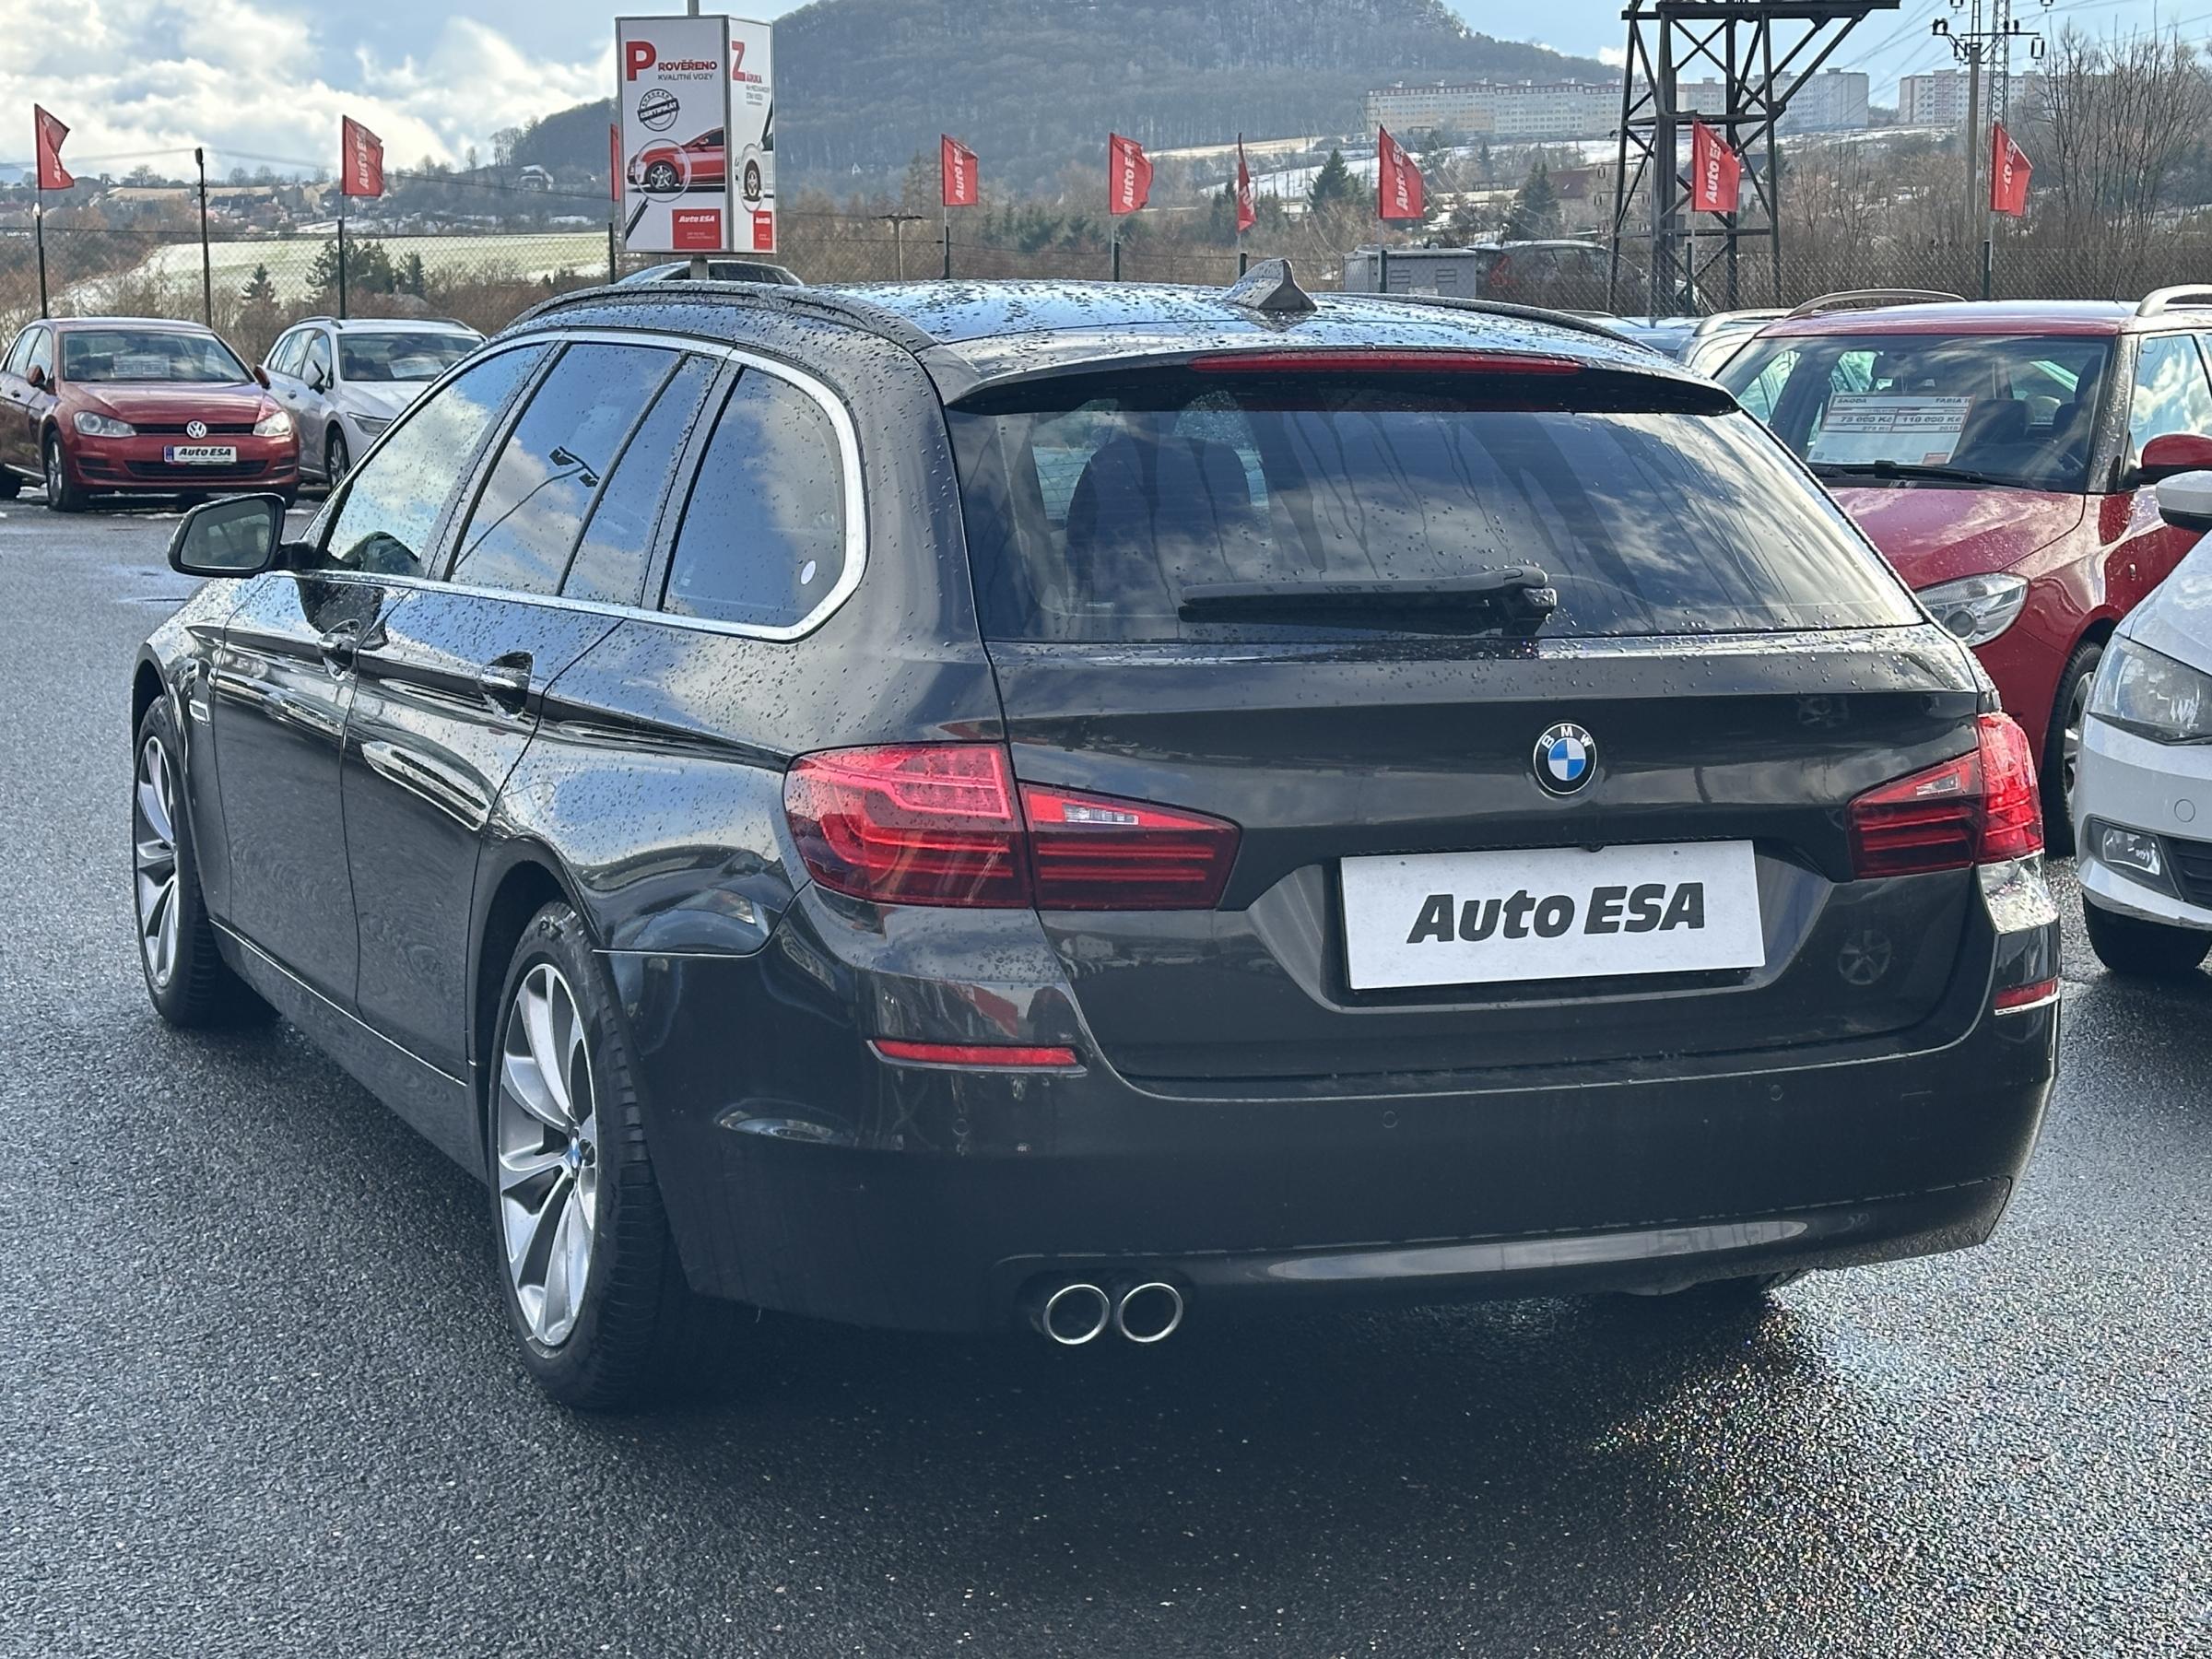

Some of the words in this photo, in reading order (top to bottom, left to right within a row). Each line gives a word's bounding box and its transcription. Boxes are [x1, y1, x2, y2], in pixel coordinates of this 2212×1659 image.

[657, 71, 691, 81] KVALITNÍ
[693, 73, 713, 81] VOZY
[955, 167, 965, 201] Auto
[1122, 168, 1135, 208] Auto
[1705, 160, 1720, 205] Auto
[678, 215, 699, 223] Auto
[179, 448, 208, 456] Auto
[209, 448, 231, 456] ESA
[1541, 725, 1594, 749] BMW
[1406, 889, 1575, 945] Auto
[1584, 881, 1705, 935] ESA
